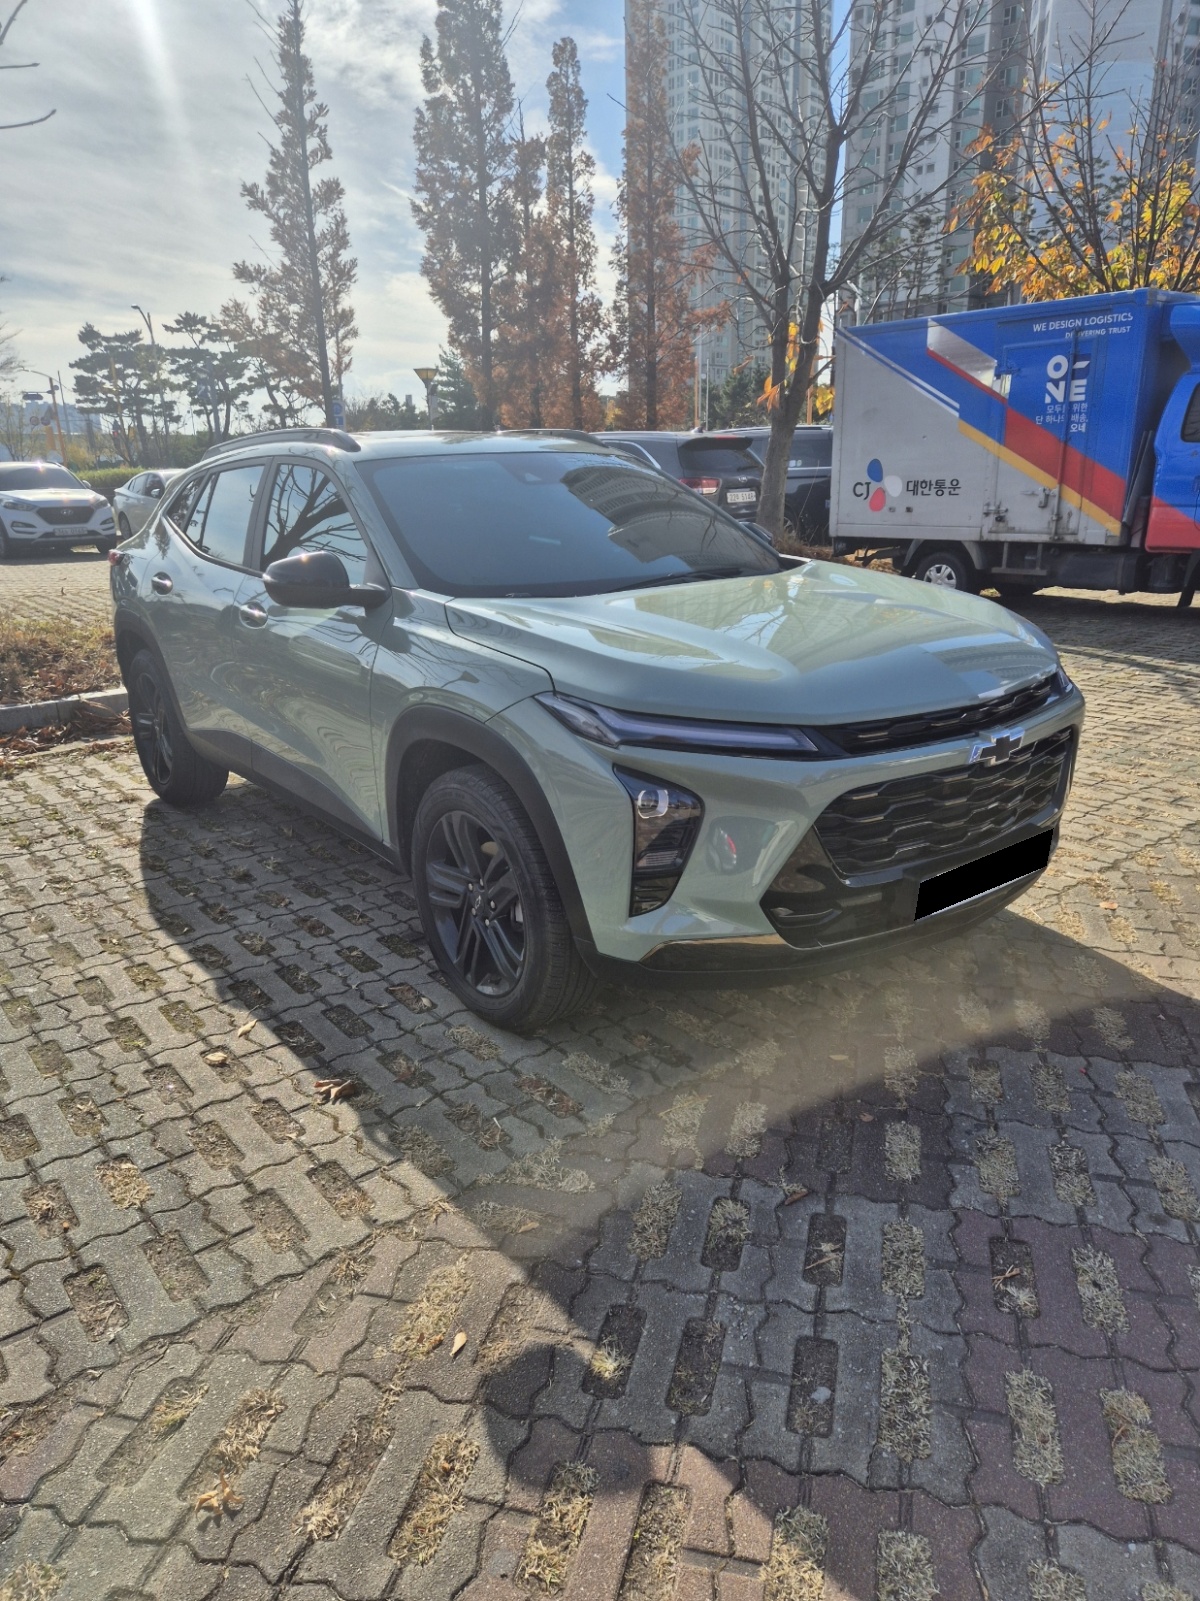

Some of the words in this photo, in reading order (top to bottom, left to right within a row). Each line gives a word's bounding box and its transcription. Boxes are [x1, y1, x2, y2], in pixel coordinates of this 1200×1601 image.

[1033, 323, 1047, 332] WE
[1049, 318, 1082, 330] DESIGN
[1084, 312, 1133, 326] LOGISTICS
[1109, 326, 1131, 335] TRUST
[1047, 404, 1066, 414] 모두
[1073, 402, 1088, 413] 위한
[1035, 414, 1043, 424] 단
[1070, 423, 1086, 433] 오네
[852, 481, 872, 501] CJ
[906, 478, 962, 497] 대한통운
